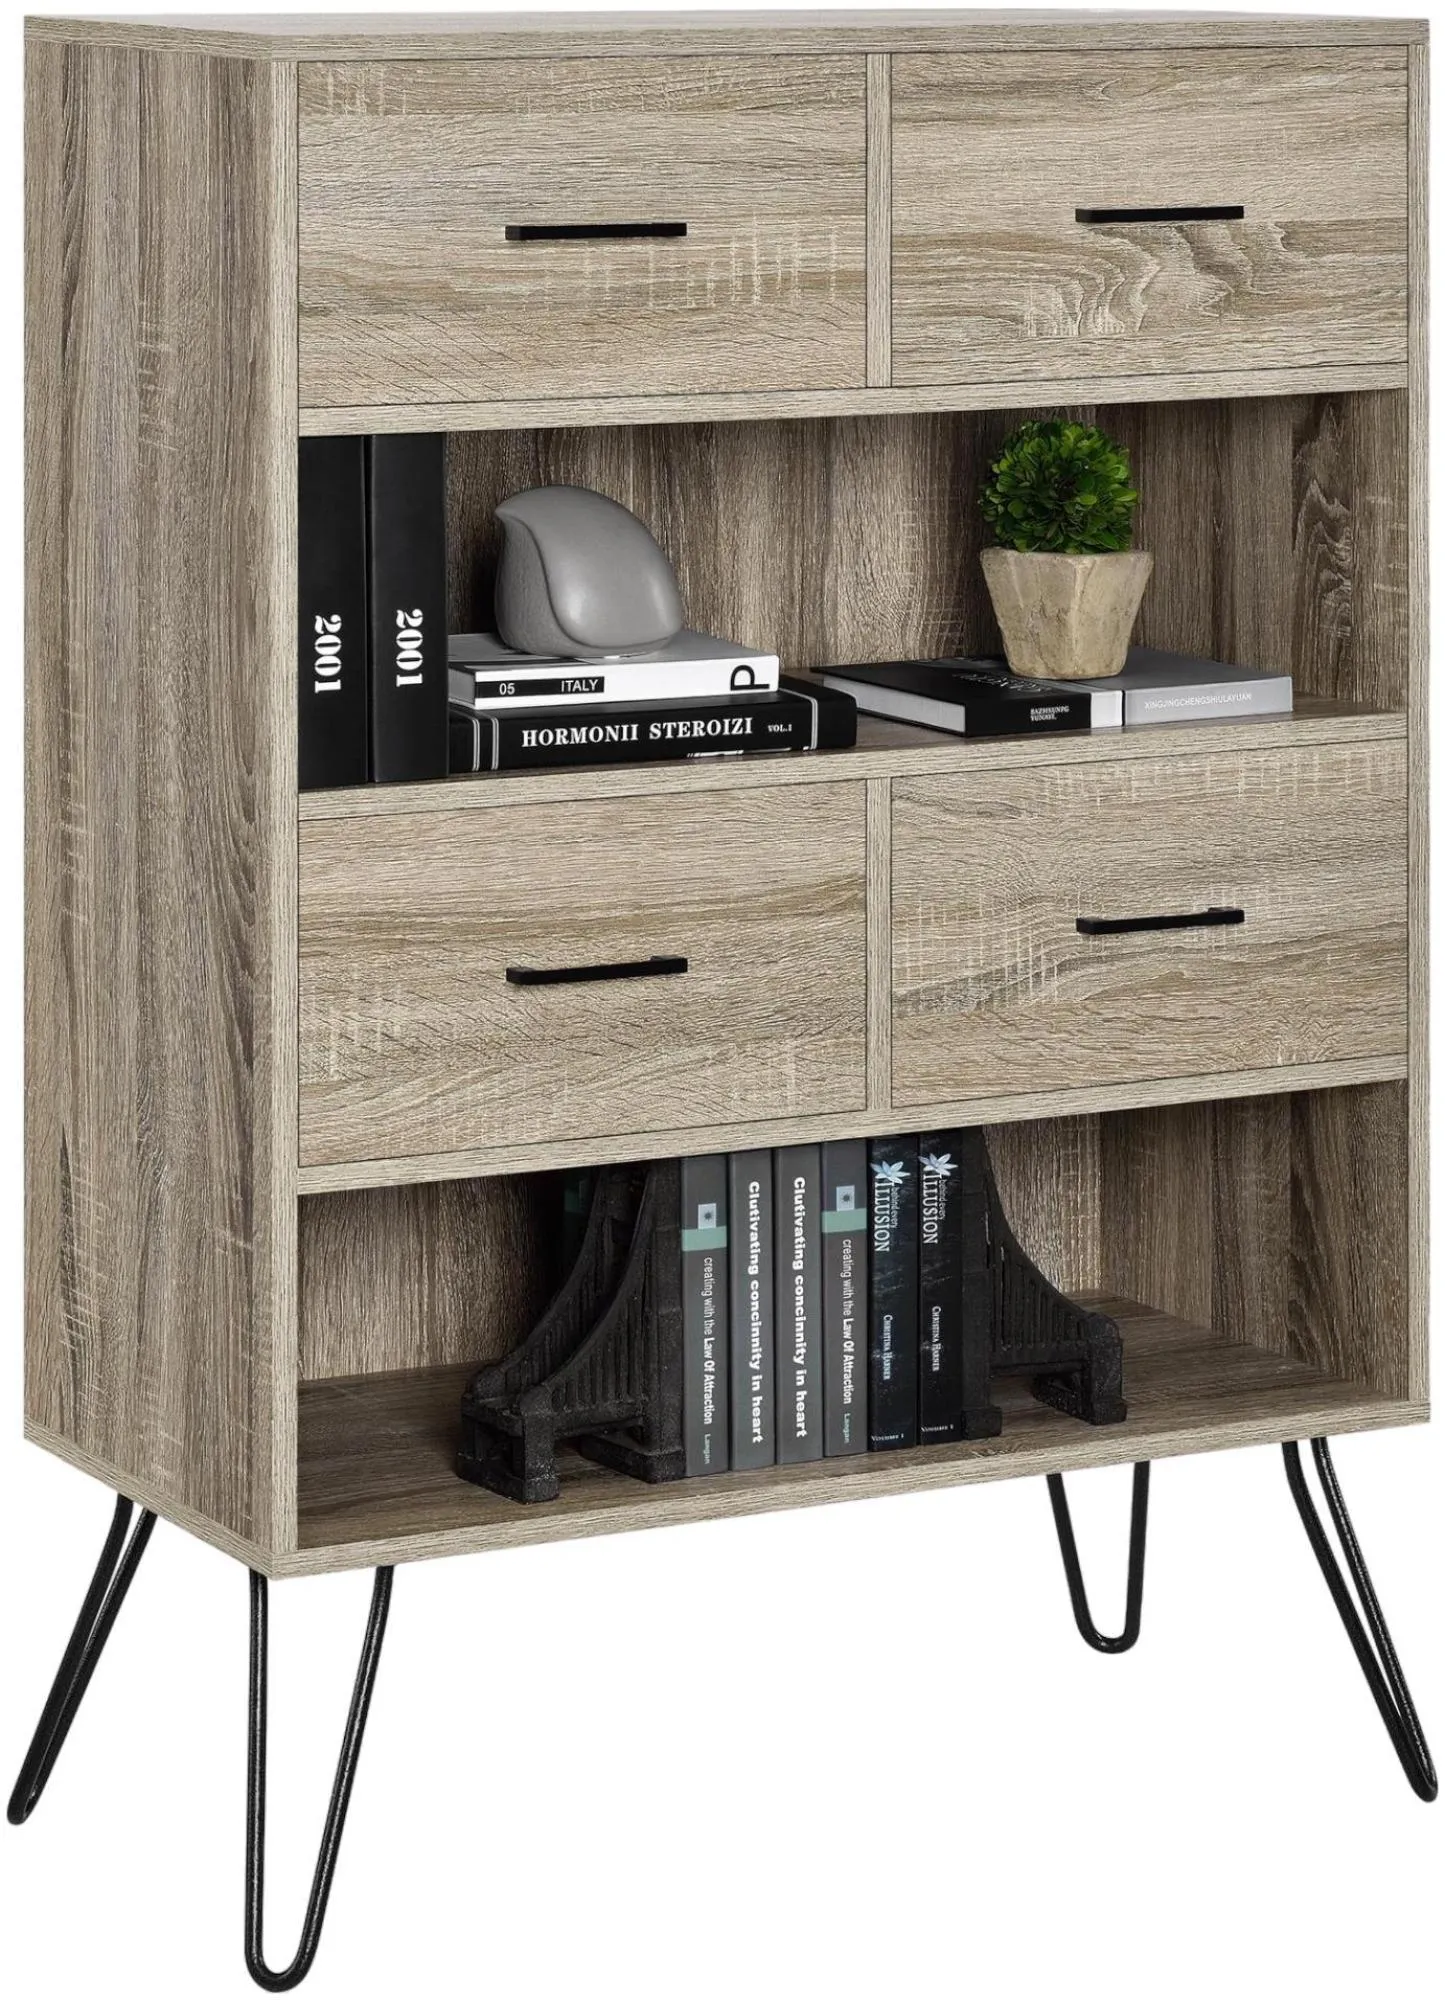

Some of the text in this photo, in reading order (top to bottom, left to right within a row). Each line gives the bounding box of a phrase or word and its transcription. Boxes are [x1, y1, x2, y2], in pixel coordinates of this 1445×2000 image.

[314, 613, 342, 694] 2001
[395, 608, 424, 688] 2001
[498, 678, 599, 696] 05 ITALY
[521, 724, 640, 748] HORMONII
[648, 716, 754, 739] STEROIZI
[873, 1180, 895, 1252] ILLUSION
[890, 1186, 901, 1210] behind
[922, 1172, 943, 1244] ILLUSION
[939, 1179, 949, 1202] behind
[701, 1257, 716, 1425] creating with the Law Of Attraction
[747, 1182, 764, 1444] Clutivating concinnity in heart
[792, 1176, 808, 1438] Clutivating concinnity in heart
[840, 1238, 855, 1405] creating with the Law Of Attraction
